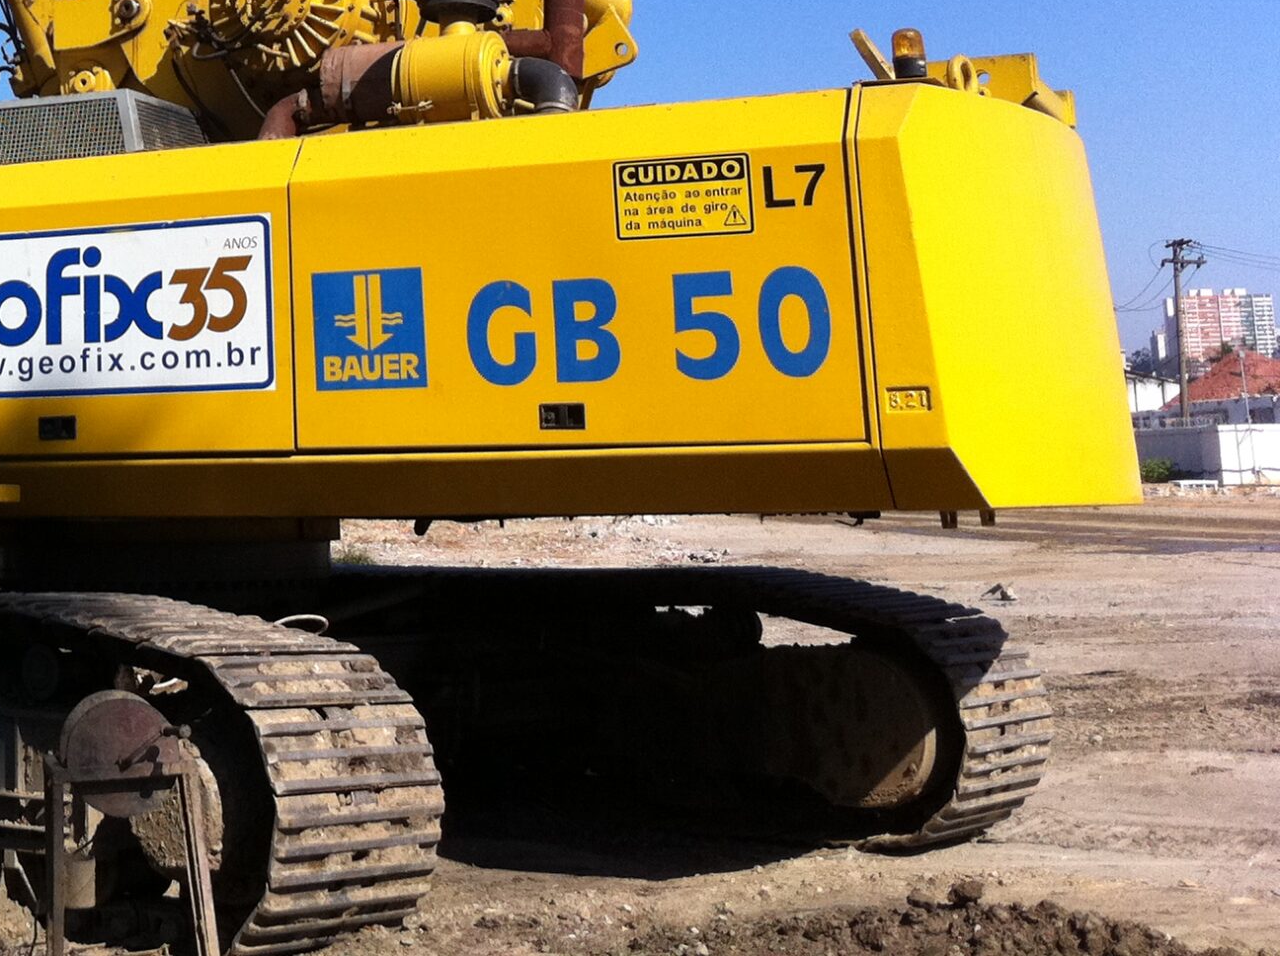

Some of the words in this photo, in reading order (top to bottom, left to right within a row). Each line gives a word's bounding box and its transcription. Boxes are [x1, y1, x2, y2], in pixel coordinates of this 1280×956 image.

[622, 160, 741, 185] CUIDADO
[624, 190, 677, 202] Atenção
[685, 190, 700, 198] ao
[705, 186, 743, 198] entrar
[762, 163, 826, 209] L7
[624, 207, 639, 216] na
[646, 204, 674, 215] área
[681, 203, 696, 213] de
[704, 201, 728, 214] giro
[625, 220, 640, 230] da
[648, 218, 702, 230] máquina
[223, 235, 258, 250] ANOS
[167, 254, 253, 342] 35
[466, 277, 621, 386] GB
[672, 265, 831, 381] 50
[323, 352, 419, 382] BAUER
